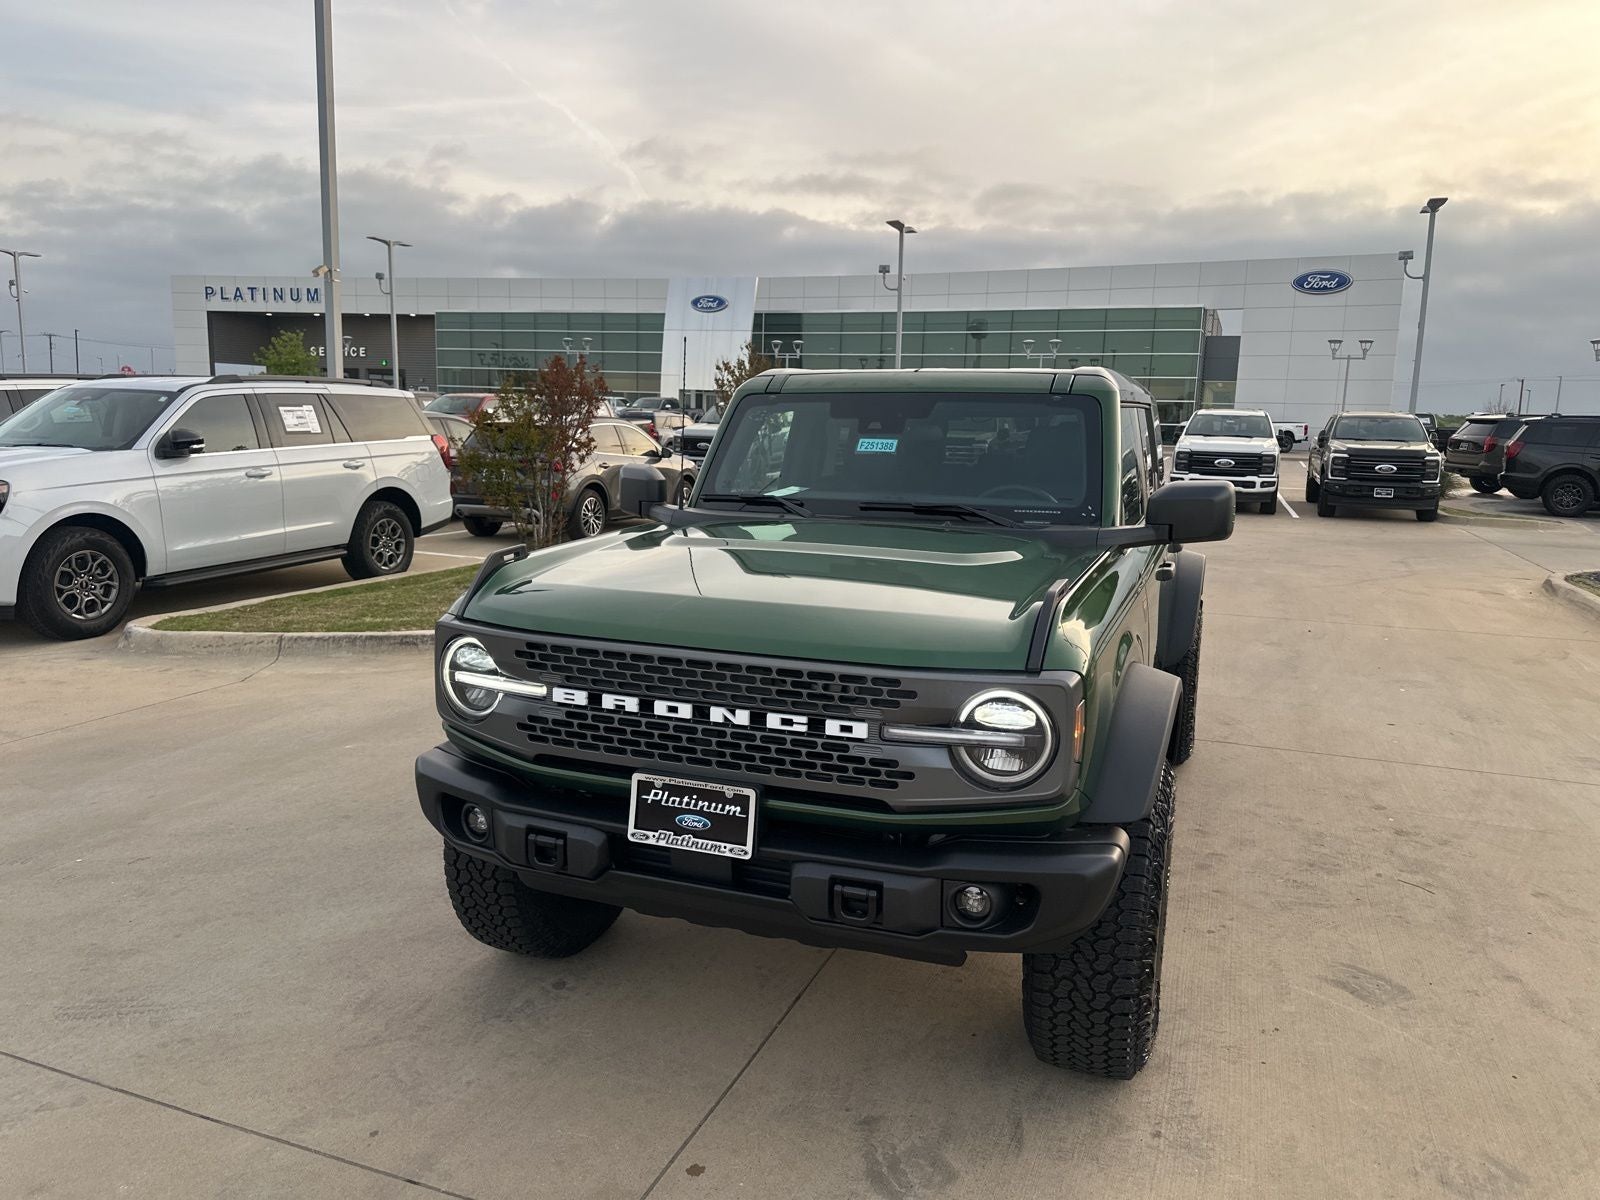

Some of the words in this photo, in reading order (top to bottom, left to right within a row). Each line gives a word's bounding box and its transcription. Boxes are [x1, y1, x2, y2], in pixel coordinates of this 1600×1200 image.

[1303, 274, 1339, 289] Ford
[204, 286, 320, 302] PLATINUM
[697, 297, 719, 308] Ford
[310, 346, 366, 357] SEICE
[859, 441, 895, 451] F251388
[552, 686, 869, 739] BRONCO
[644, 776, 744, 794] www.PlatinumFord.com
[641, 789, 747, 818] Platinum
[682, 816, 704, 829] Ford
[655, 831, 726, 854] Platinum
